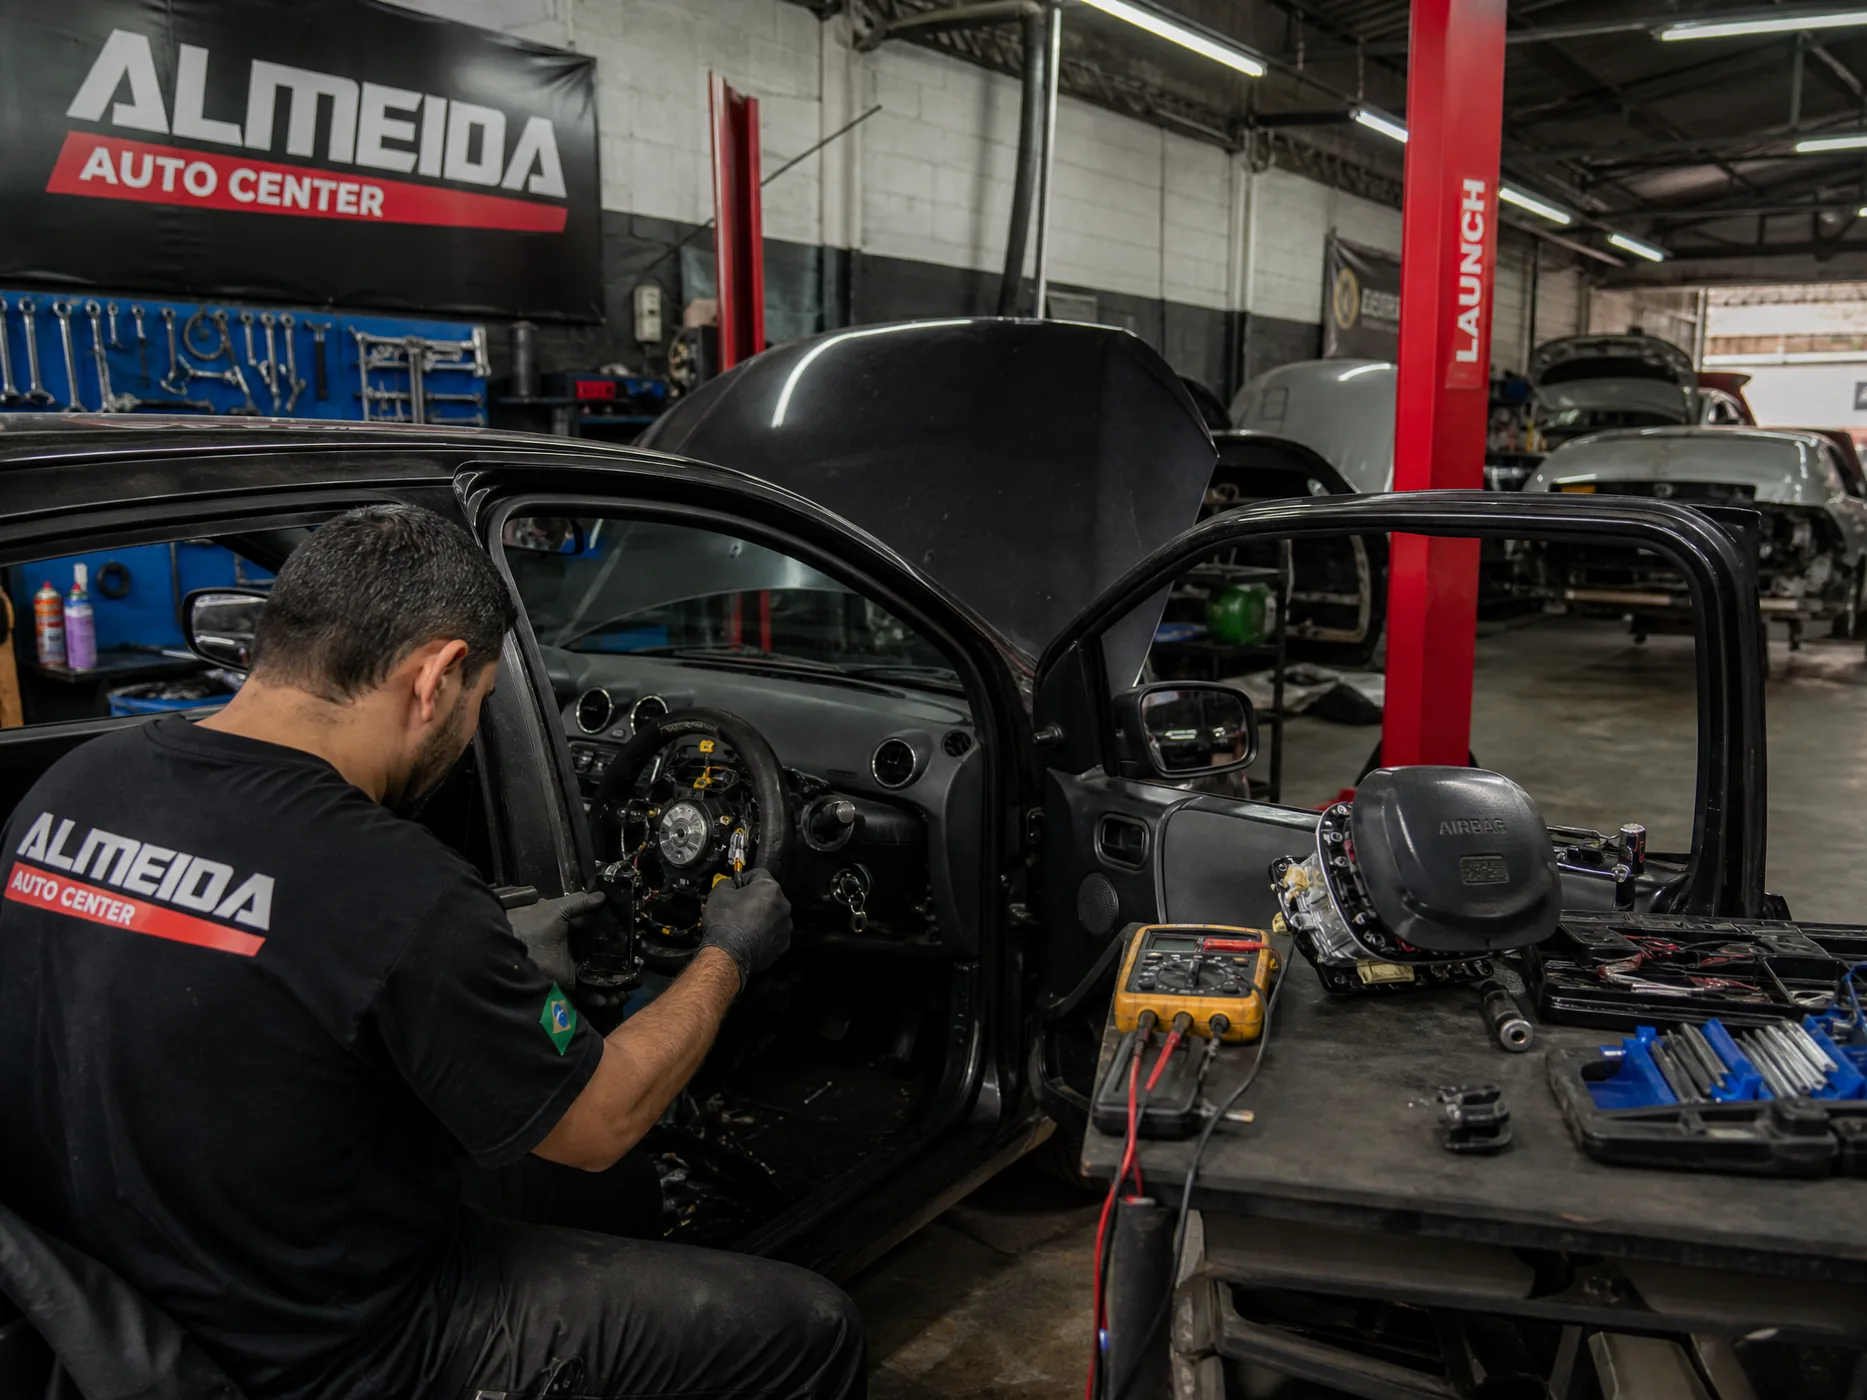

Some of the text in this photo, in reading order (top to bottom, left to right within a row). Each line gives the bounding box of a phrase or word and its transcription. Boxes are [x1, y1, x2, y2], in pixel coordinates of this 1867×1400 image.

[66, 29, 567, 198] ALMEIDA
[79, 147, 384, 217] AUTO CENTER
[1456, 178, 1485, 363] LAUNCH
[16, 811, 275, 930] ALMEIDA
[1439, 818, 1507, 835] AIRBAG
[11, 870, 136, 925] AUTO CENTER
